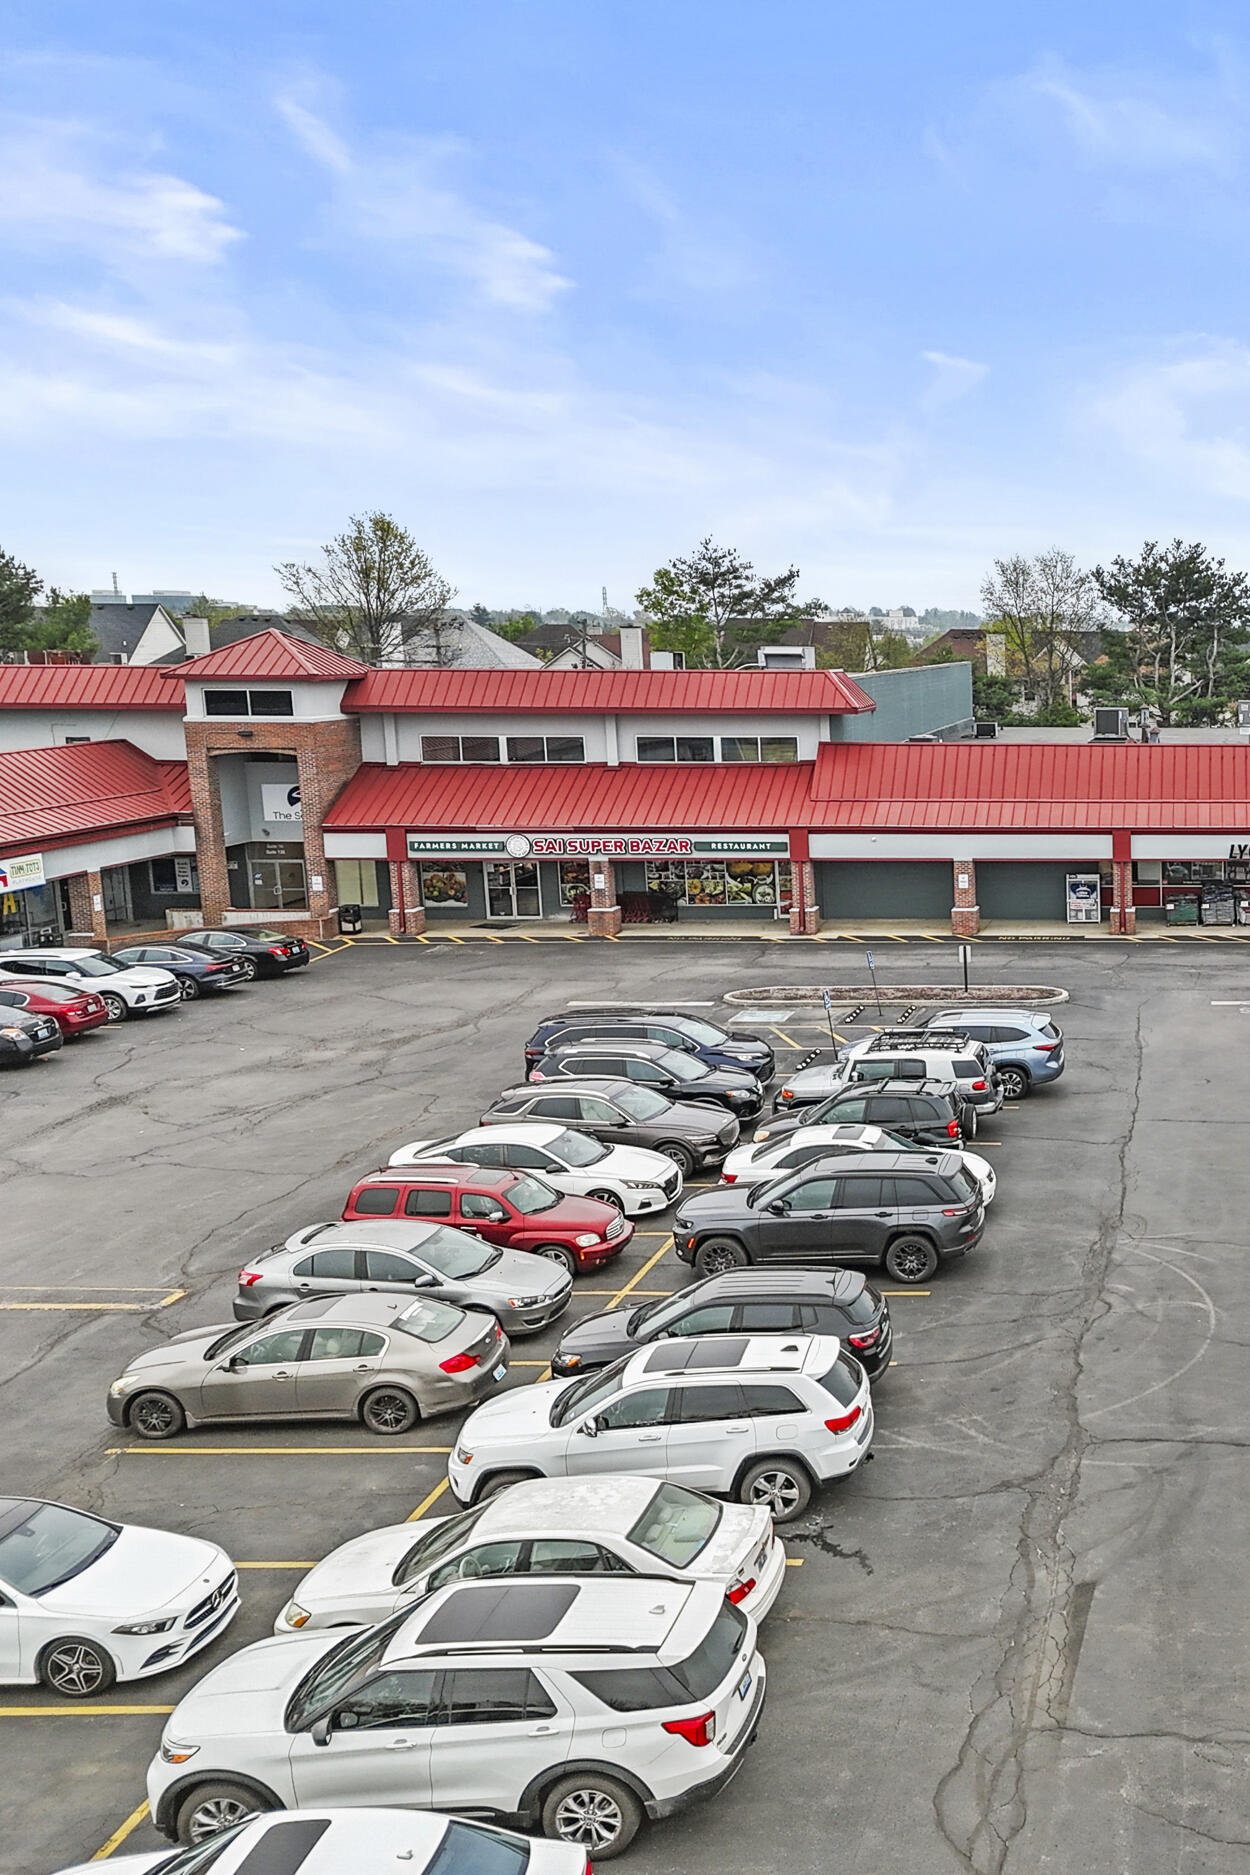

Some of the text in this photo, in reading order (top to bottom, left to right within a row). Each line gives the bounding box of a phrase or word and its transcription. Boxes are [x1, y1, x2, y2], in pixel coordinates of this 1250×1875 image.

[273, 811, 292, 821] The
[414, 842, 499, 850] FARMERS MARKET
[533, 840, 563, 852] SAI
[567, 840, 625, 852] SUPER
[629, 840, 690, 852] BAZAR
